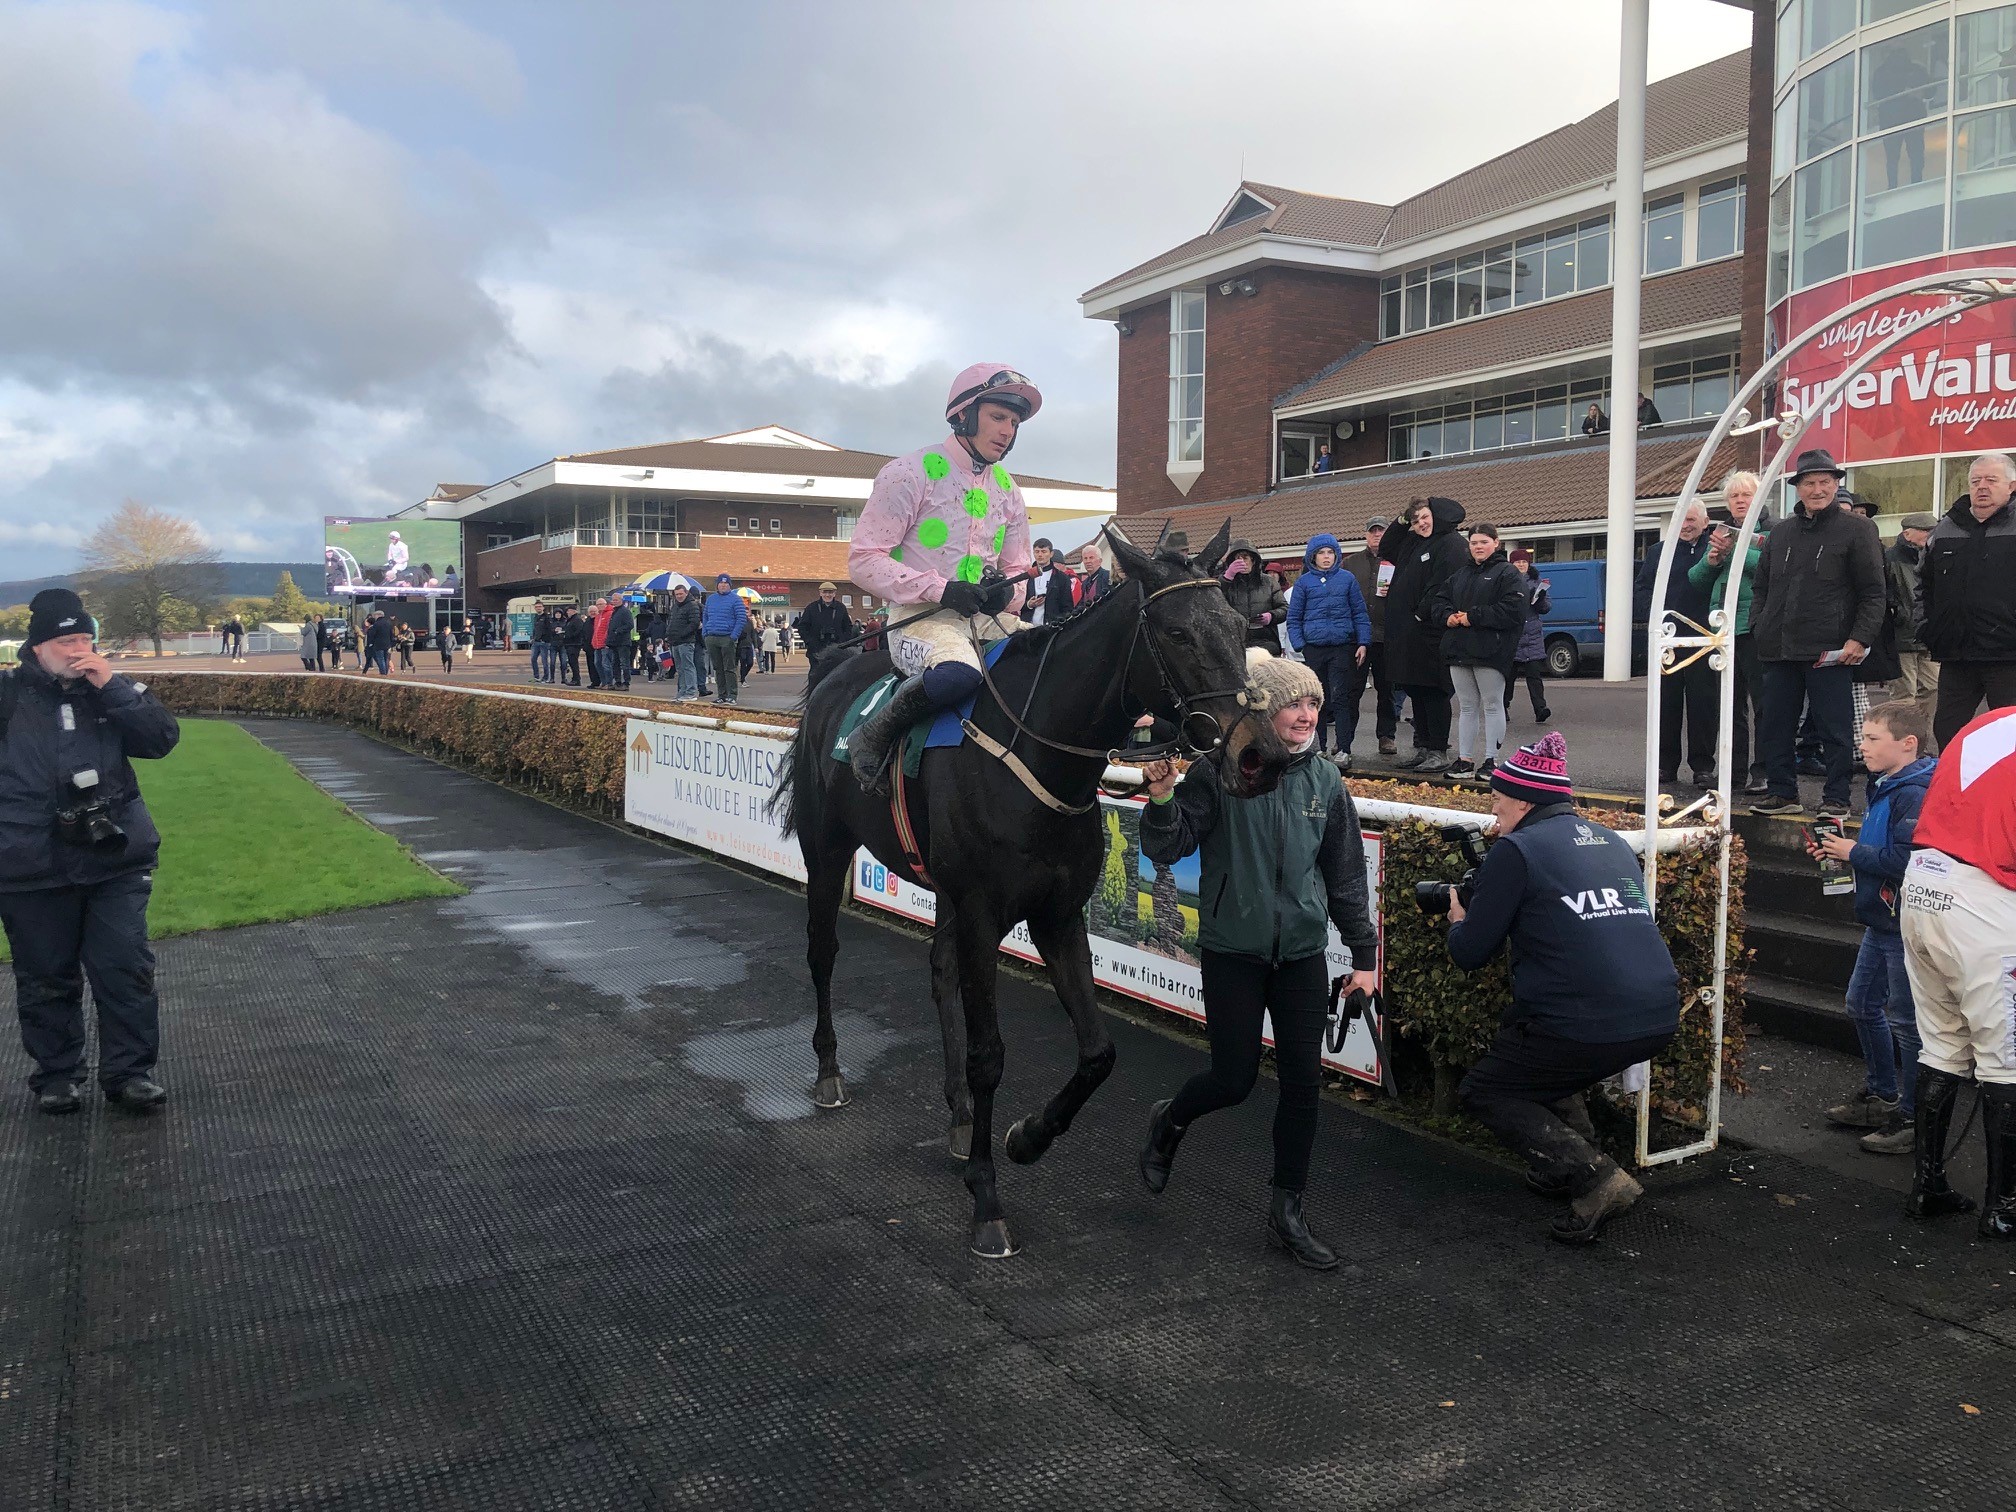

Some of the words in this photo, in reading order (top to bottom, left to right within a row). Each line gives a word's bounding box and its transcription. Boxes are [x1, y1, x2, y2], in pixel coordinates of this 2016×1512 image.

[1783, 342, 2016, 429] SuperValu
[1929, 396, 2016, 434] Hollyhil
[655, 733, 712, 775] LEISURE
[716, 742, 774, 789] DOMES
[674, 777, 740, 816] MARQUEE
[749, 795, 788, 828] HIRE
[706, 830, 807, 872] www.leisuredomes.c
[1560, 888, 1624, 914] VLR
[1906, 894, 1952, 912] GROUP
[1908, 883, 1954, 904] COMER
[1579, 909, 1610, 921] Virtual
[1612, 907, 1627, 916] Live
[1627, 906, 1649, 916] Racing
[1011, 926, 1034, 945] 193
